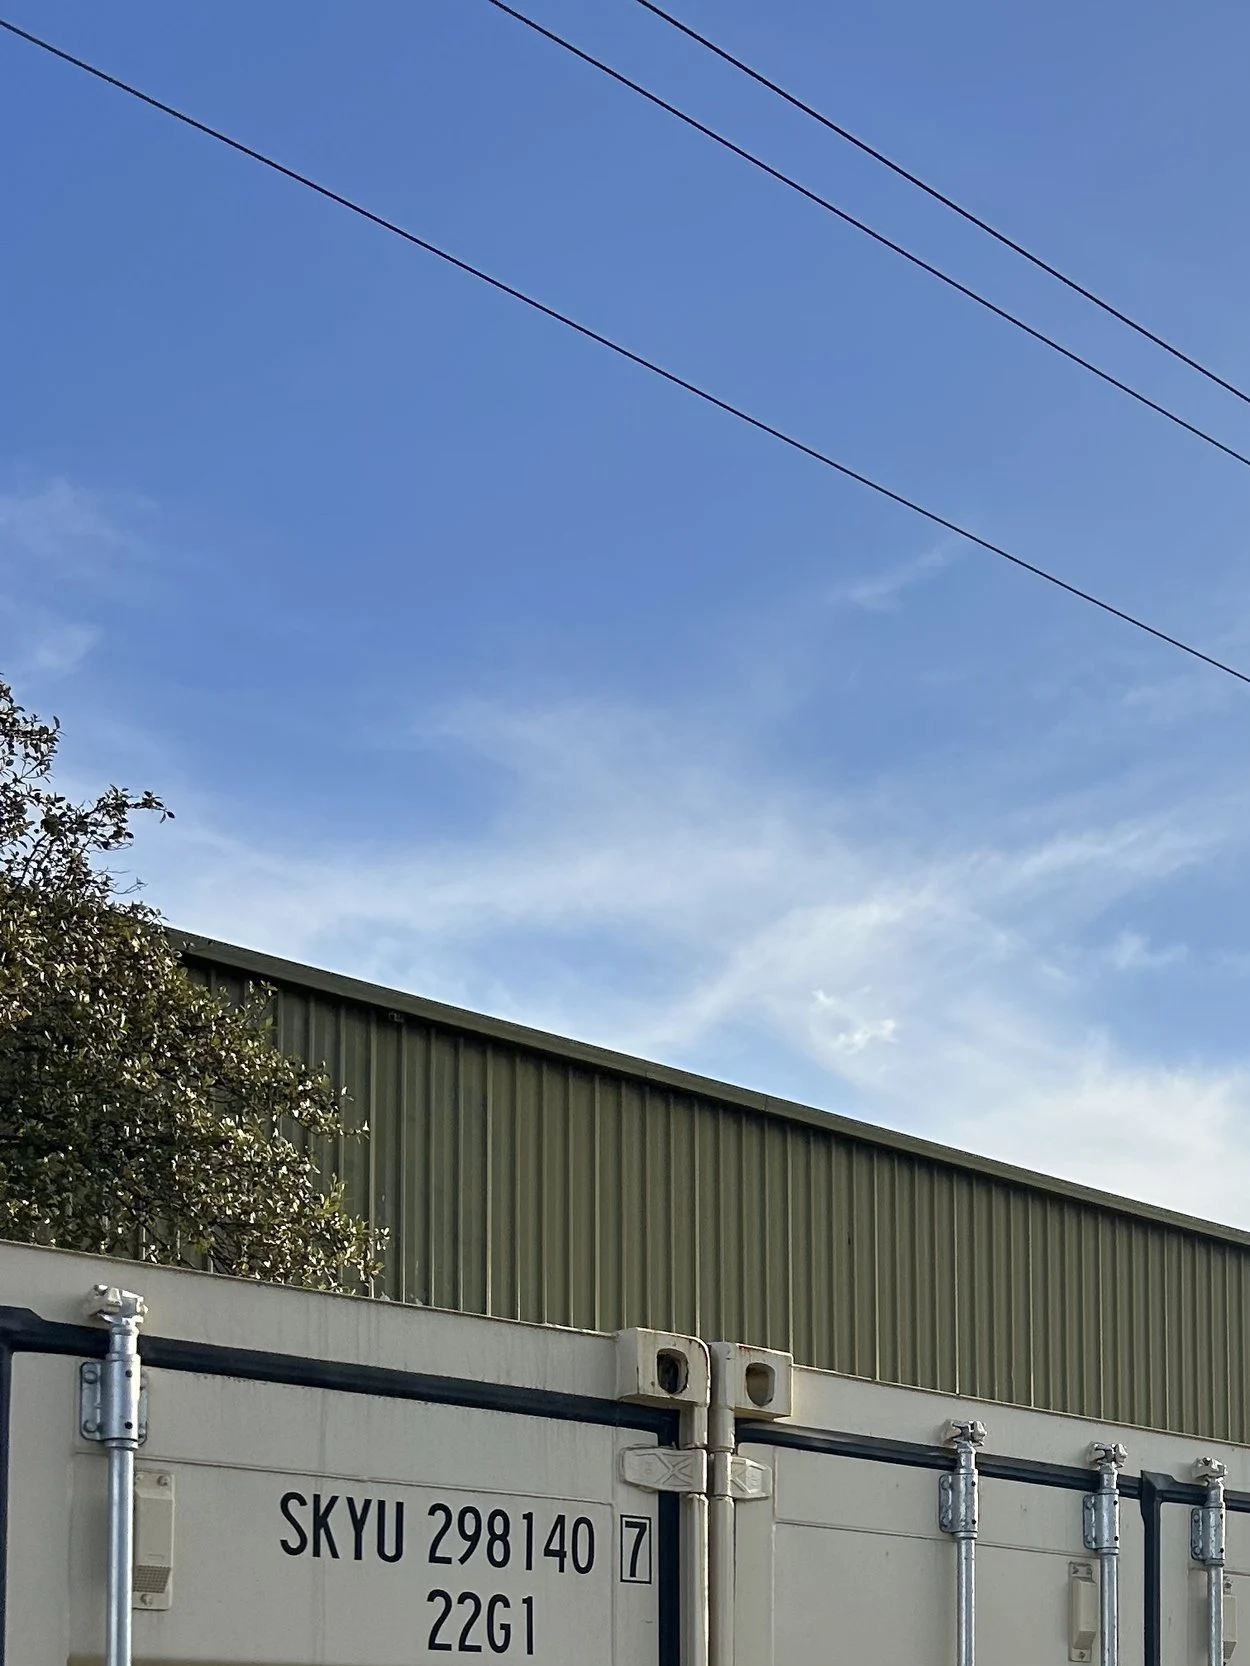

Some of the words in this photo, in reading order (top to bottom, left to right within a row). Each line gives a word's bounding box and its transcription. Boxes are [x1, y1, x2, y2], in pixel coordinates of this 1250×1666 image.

[279, 1491, 405, 1563] SKYU
[427, 1502, 595, 1575] 298140
[624, 1521, 646, 1578] 7
[426, 1589, 535, 1656] 22G1
